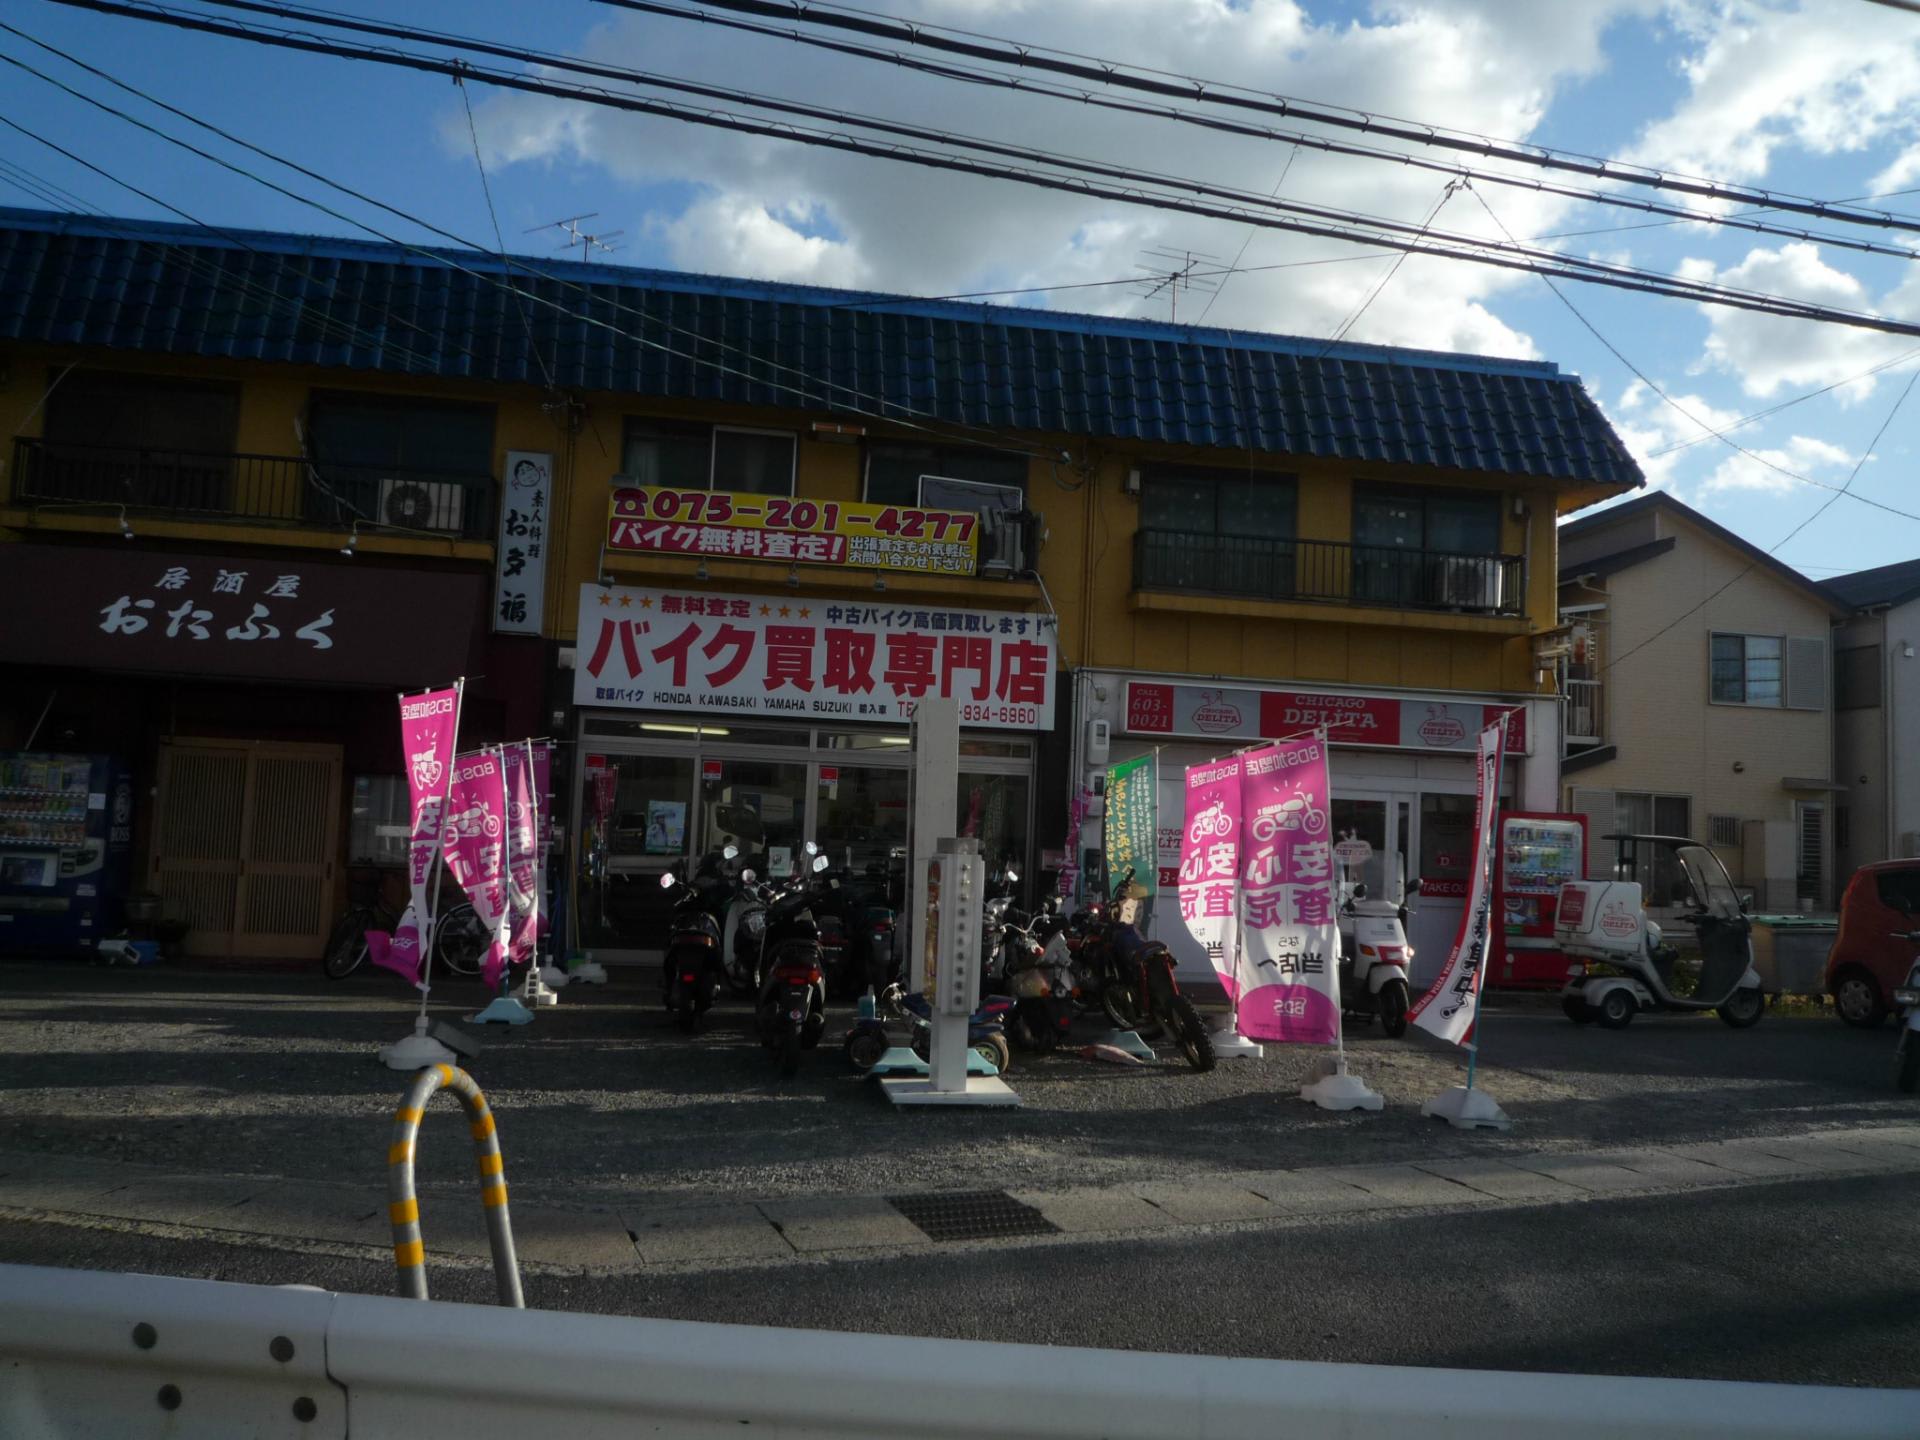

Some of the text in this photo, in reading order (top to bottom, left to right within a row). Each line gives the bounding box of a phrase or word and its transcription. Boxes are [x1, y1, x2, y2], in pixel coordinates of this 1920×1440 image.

[653, 491, 975, 541] 075-201-4277
[612, 521, 844, 560] バイク無料査定!
[850, 536, 971, 558] 出張査定もお気軽に
[154, 567, 300, 598] 居酒屋
[661, 595, 751, 618] 無料査定
[99, 595, 335, 649] おたふく
[587, 618, 1048, 704] バイク買取専門店
[596, 687, 644, 702] 取扱バイク
[653, 691, 692, 705] HONDA
[700, 694, 756, 708] KAWASAKI
[764, 698, 805, 711] YAMAHA
[813, 700, 852, 713] SUZUKI
[859, 703, 887, 715] 輸入車
[897, 701, 914, 717] TE
[1136, 688, 1160, 697] CALL
[1294, 695, 1366, 709] CHICAGO
[1132, 698, 1168, 712] 603-
[1129, 713, 1168, 728] 0021
[1423, 882, 1449, 893] TAKE
